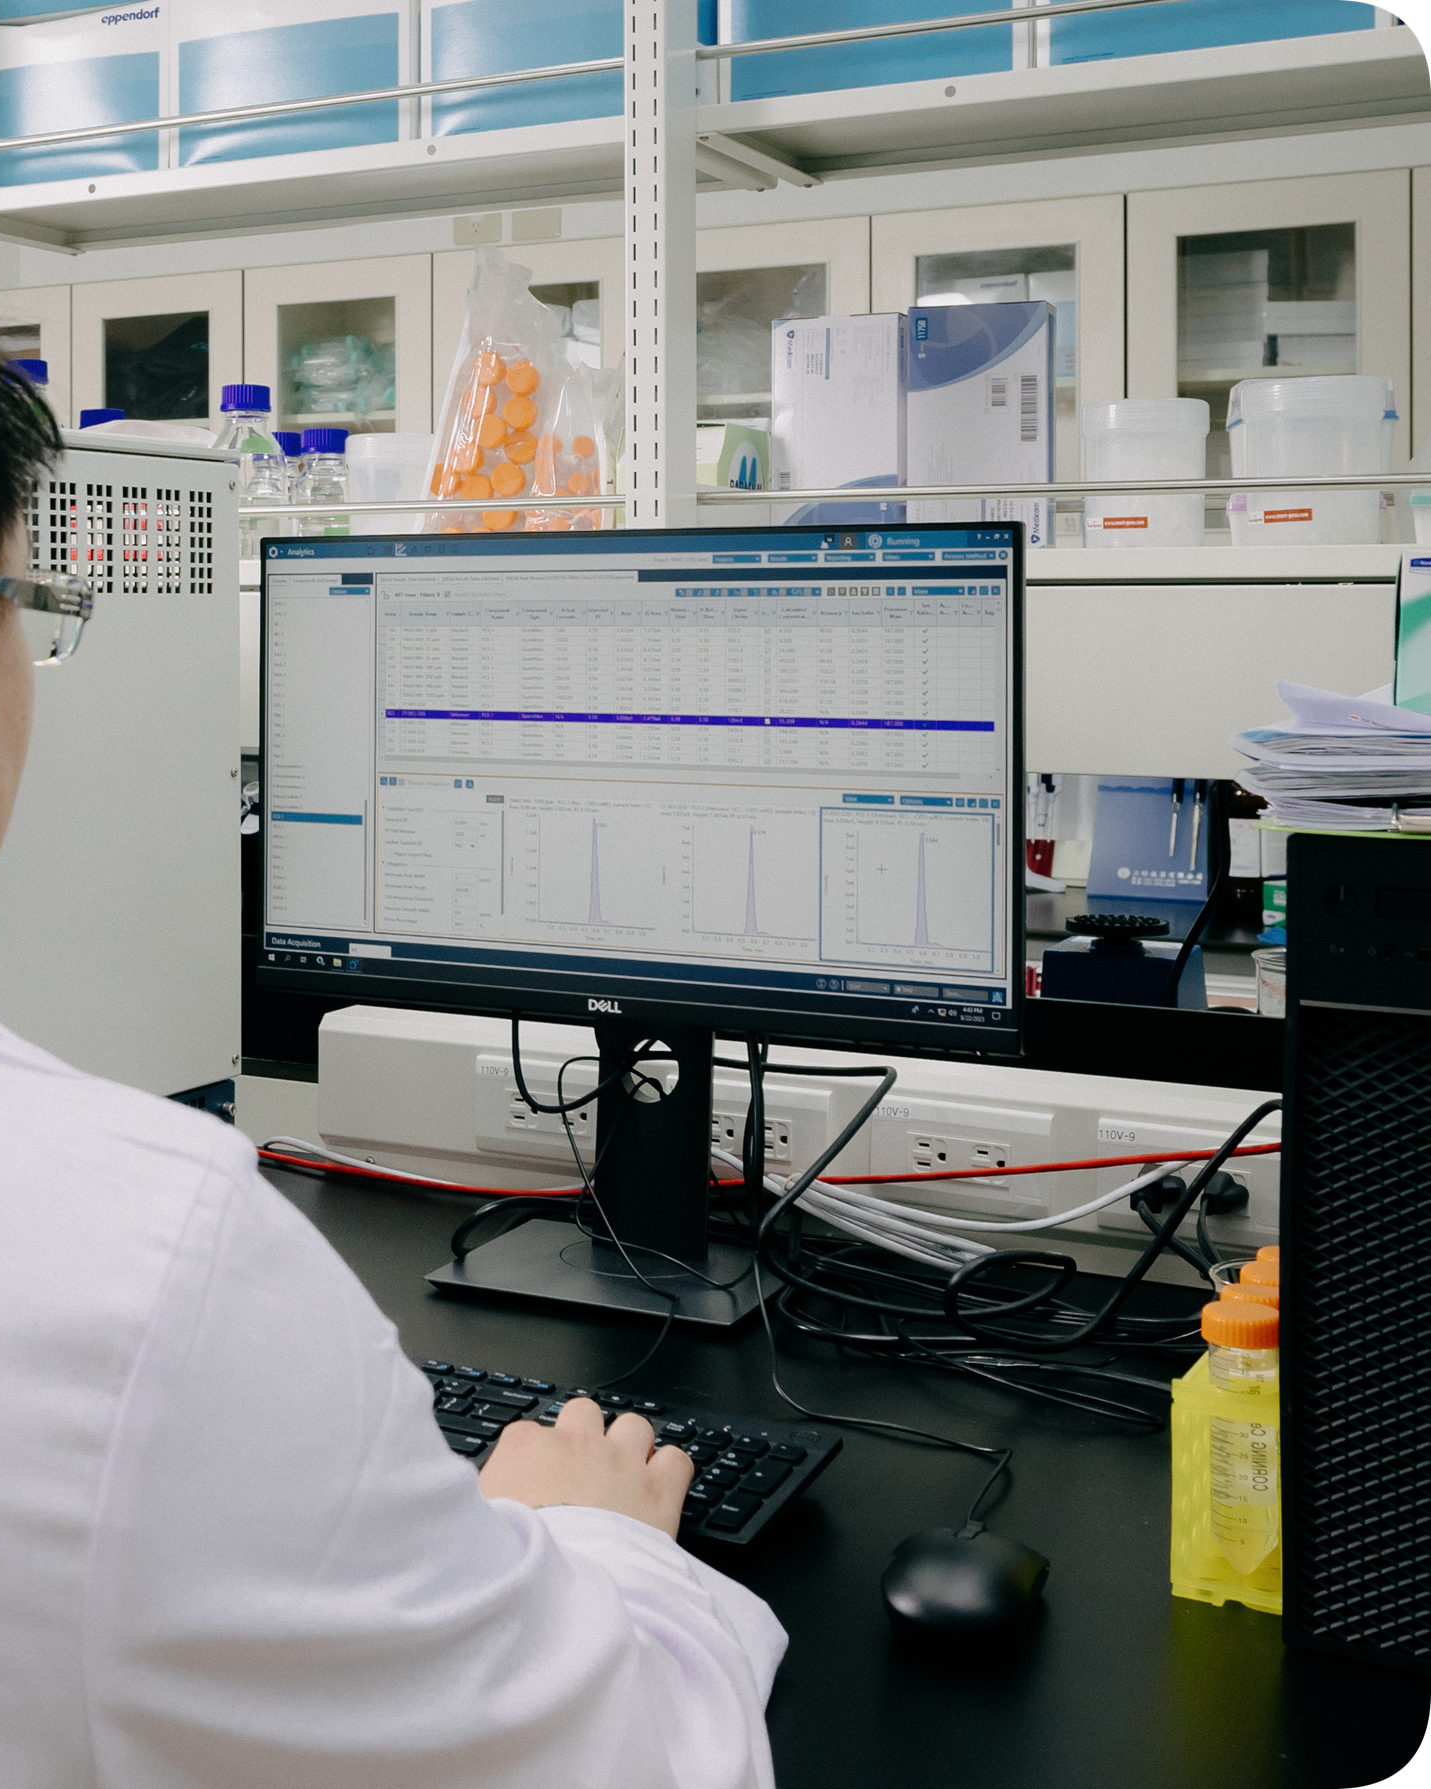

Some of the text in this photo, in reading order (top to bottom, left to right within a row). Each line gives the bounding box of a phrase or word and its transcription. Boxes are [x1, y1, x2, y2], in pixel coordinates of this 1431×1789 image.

[101, 7, 160, 26] eppendorf
[886, 536, 921, 547] Running
[287, 548, 315, 558] Analytics
[826, 554, 852, 563] Reporting
[271, 937, 321, 948] Data Acquisition
[588, 998, 622, 1014] DELL
[479, 1065, 510, 1078] 110V-9
[874, 1106, 910, 1117] 110V-9
[1098, 1129, 1136, 1142] 110V-9
[1238, 1517, 1248, 1525] 10
